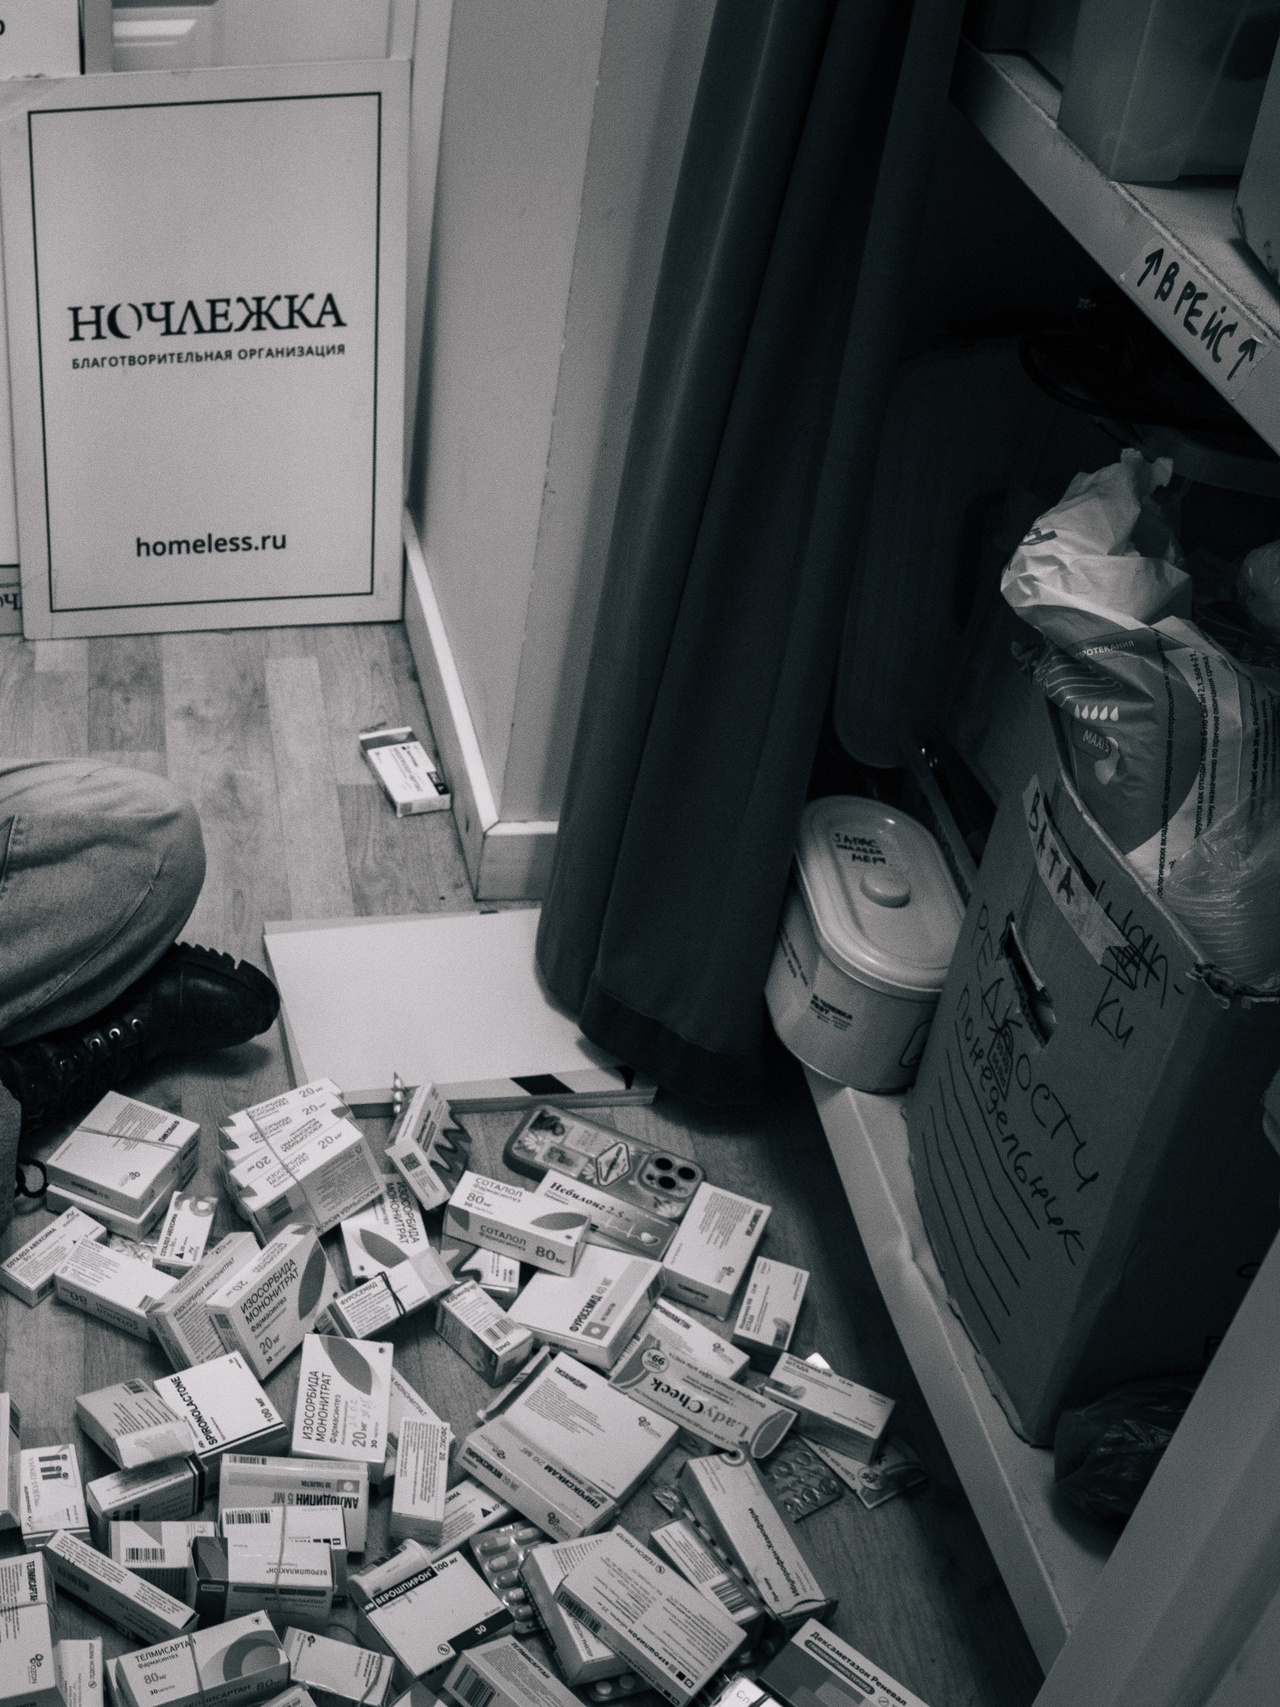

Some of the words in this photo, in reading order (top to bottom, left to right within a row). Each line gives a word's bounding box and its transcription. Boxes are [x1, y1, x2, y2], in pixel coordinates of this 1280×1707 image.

[68, 292, 348, 342] НОЧЛЕЖКА
[1154, 262, 1179, 302] В
[1173, 281, 1238, 363] РЕЙС
[72, 349, 233, 369] БЛАГОТВОРИТЕЛЬНАЯ
[238, 343, 346, 361] ОРГАНИЗАЦИЯ
[136, 533, 287, 557] homeless.ru
[1076, 640, 1135, 657] РОТЕКАНИЯ
[1198, 762, 1206, 789] отходы
[299, 1087, 315, 1098] 20
[302, 1104, 319, 1116] 20
[318, 1136, 334, 1149] 20
[255, 1156, 271, 1170] 20
[466, 1192, 485, 1205] 80
[474, 1177, 523, 1197] СОТАЛОЛ
[548, 1181, 607, 1211] Небилонг
[385, 1182, 410, 1245] МОНОНИТРАТ
[395, 1181, 420, 1245] ИЗОСОРБИДА
[5, 1247, 31, 1268] СОТАЛОЛ
[28, 1226, 57, 1250] АВЕКСИМА
[480, 1224, 527, 1246] СОТАЛОЛ
[534, 1245, 556, 1261] 80
[171, 1284, 206, 1317] ИЗОСОРБИДА
[202, 1256, 236, 1288] МОНОНИТРАТ
[238, 1258, 297, 1313] ИЗОСОРБИДА
[242, 1266, 303, 1324] МОНОНИТРАТ
[339, 1281, 378, 1306] ФУРОСЕМИД
[249, 1295, 288, 1332] Фармасинтез
[568, 1291, 602, 1334] ФУРОСЕМИД
[260, 1335, 273, 1355] 20
[171, 1376, 218, 1446] SPIRONOLACTONE
[261, 1408, 274, 1423] 100
[301, 1370, 320, 1439] ИЗОСОРБИДА
[314, 1372, 332, 1442] МОНОНИТРАТ
[329, 1393, 341, 1443] Фармасинтез
[649, 1377, 750, 1439] LadyCheck
[351, 1431, 367, 1447] 20
[370, 1439, 377, 1448] 30
[466, 1447, 503, 1479] ПИРОКСИКАМ
[270, 1491, 285, 1503] МГ
[287, 1493, 293, 1504] 5
[544, 1464, 601, 1509] ПИРОКСИКАМ
[615, 1530, 635, 1549] РИХТЕР
[747, 1506, 800, 1598] Ибупрофен-Хемофарм
[633, 1545, 656, 1566] ГЕДЕОН
[375, 1568, 433, 1605] ВЕРОШПИРОН
[434, 1561, 449, 1573] 100
[475, 1624, 487, 1636] 30
[137, 1653, 178, 1669] Фармасинтез
[509, 1641, 551, 1679] ТЕЛМИСАРТАН
[625, 1628, 670, 1666] ВЕРОШПИРОН
[29, 1664, 37, 1684] OZON
[143, 1672, 159, 1684] 80
[809, 1629, 872, 1680] Дексаметазон
[869, 1674, 908, 1706] Реневал
